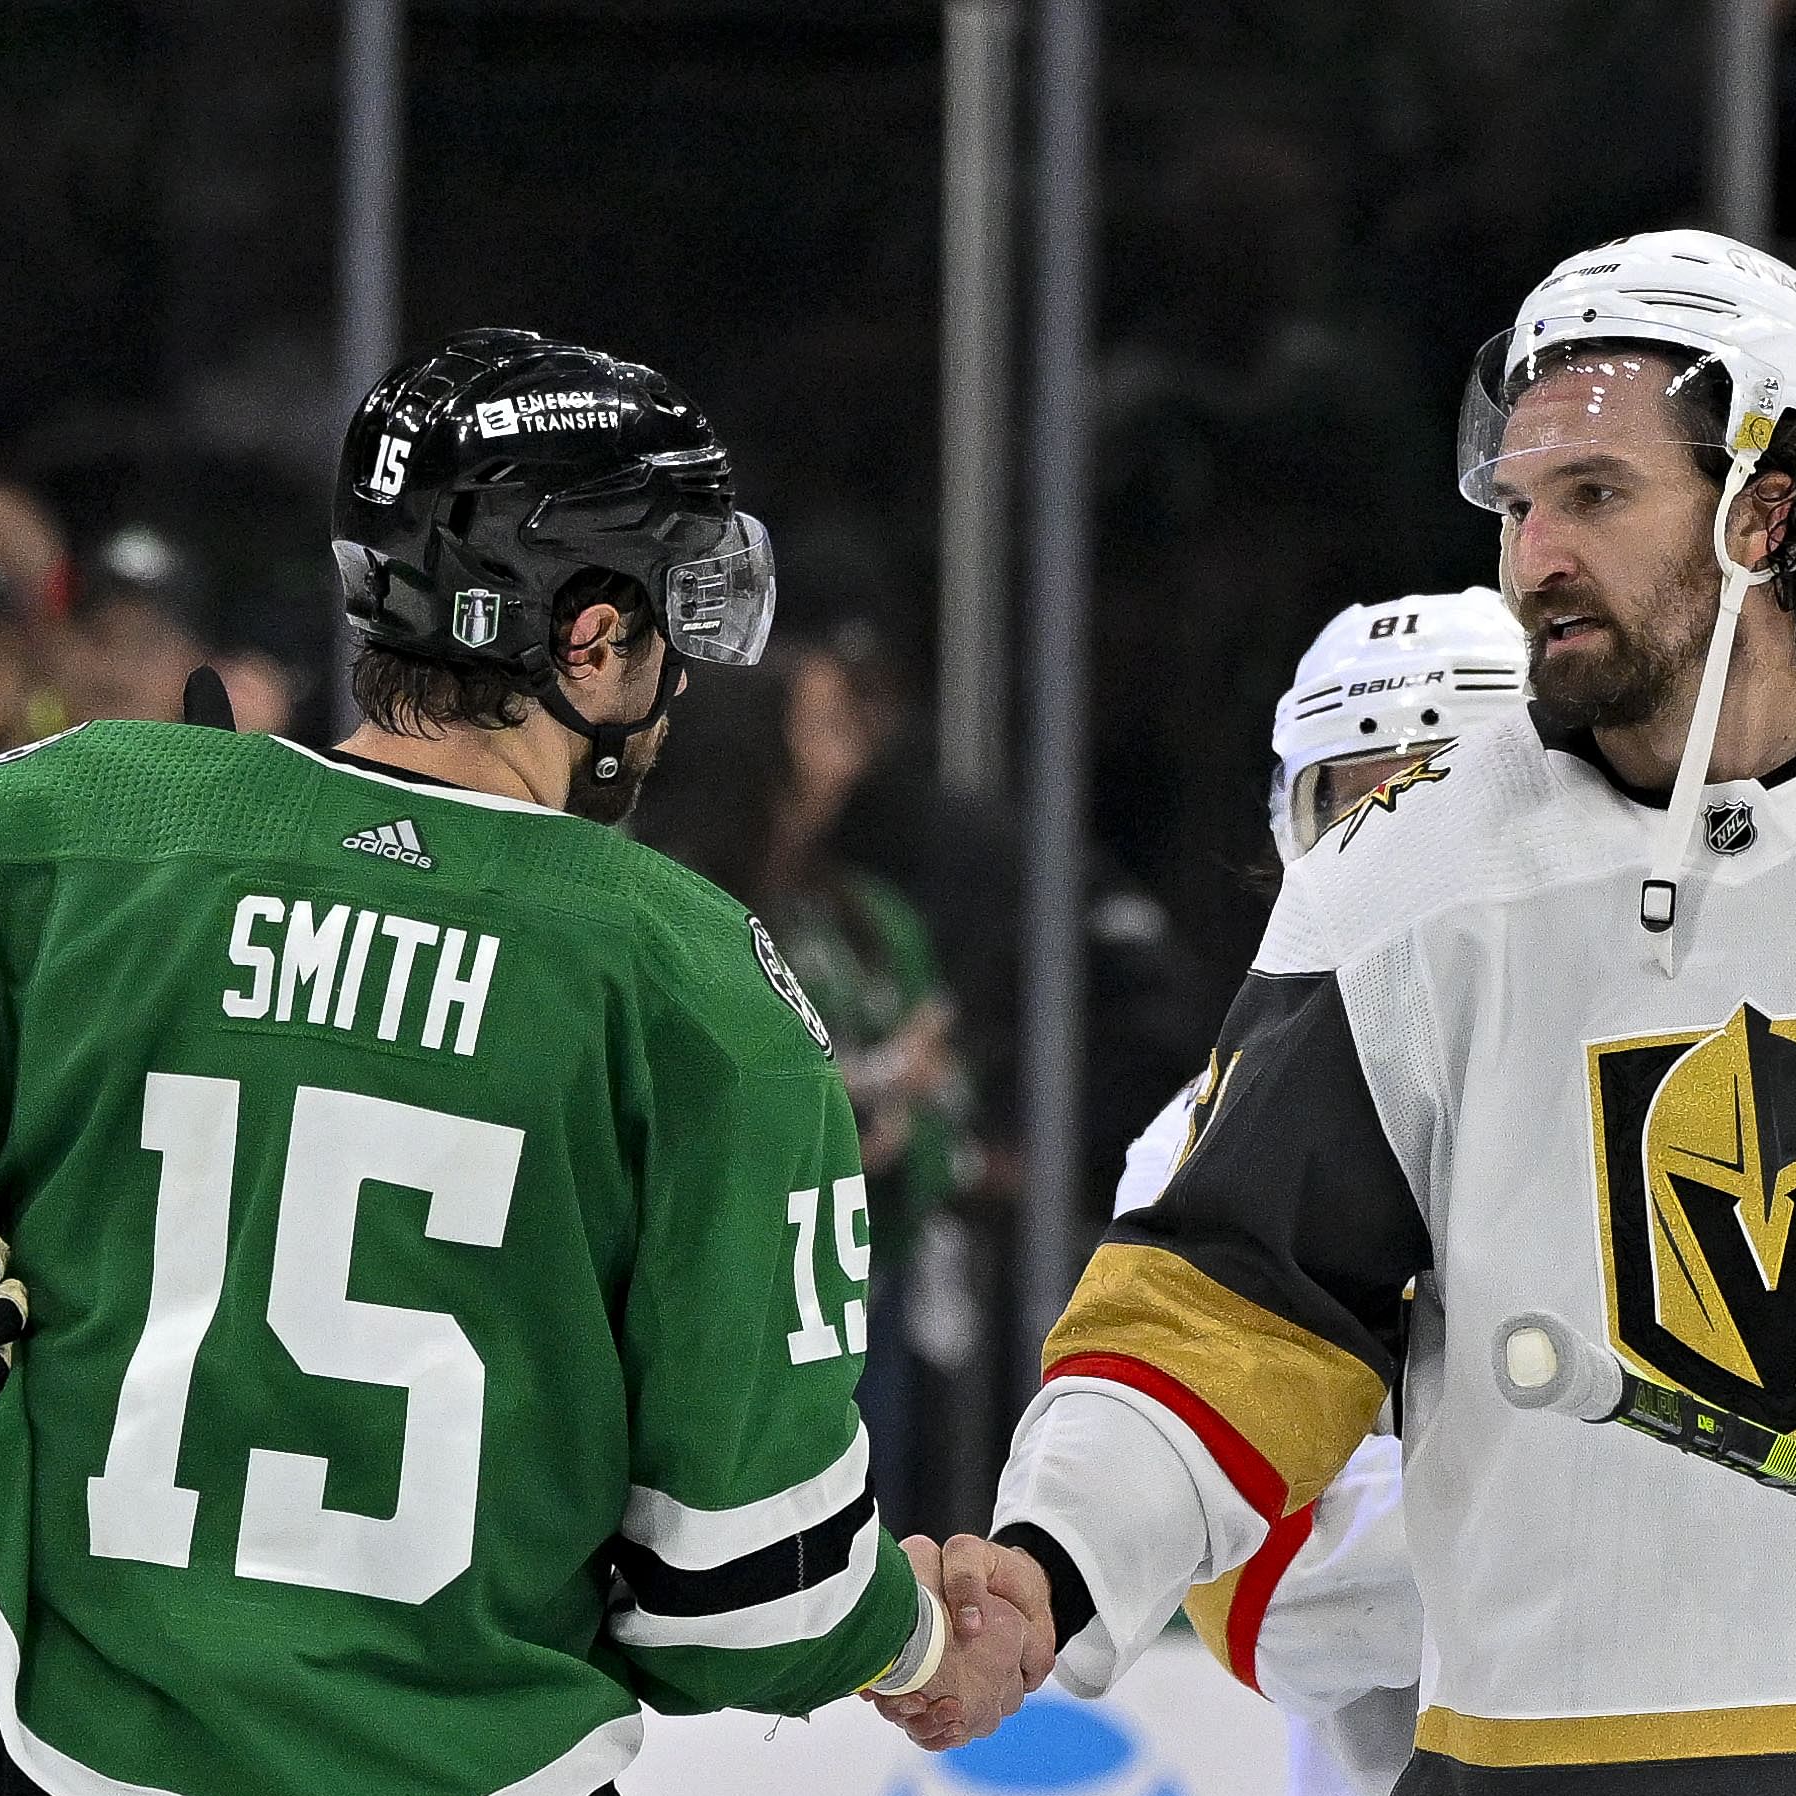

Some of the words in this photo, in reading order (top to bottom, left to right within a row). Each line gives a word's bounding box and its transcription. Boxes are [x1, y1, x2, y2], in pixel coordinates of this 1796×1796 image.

[516, 391, 595, 413] ENERGY
[521, 410, 619, 433] TRANSFER
[370, 434, 412, 496] 15
[1369, 614, 1420, 640] 81
[1347, 670, 1445, 697] BAUR
[342, 837, 433, 869] adidas
[222, 894, 501, 1057] SMITH
[86, 1072, 526, 1605] 15
